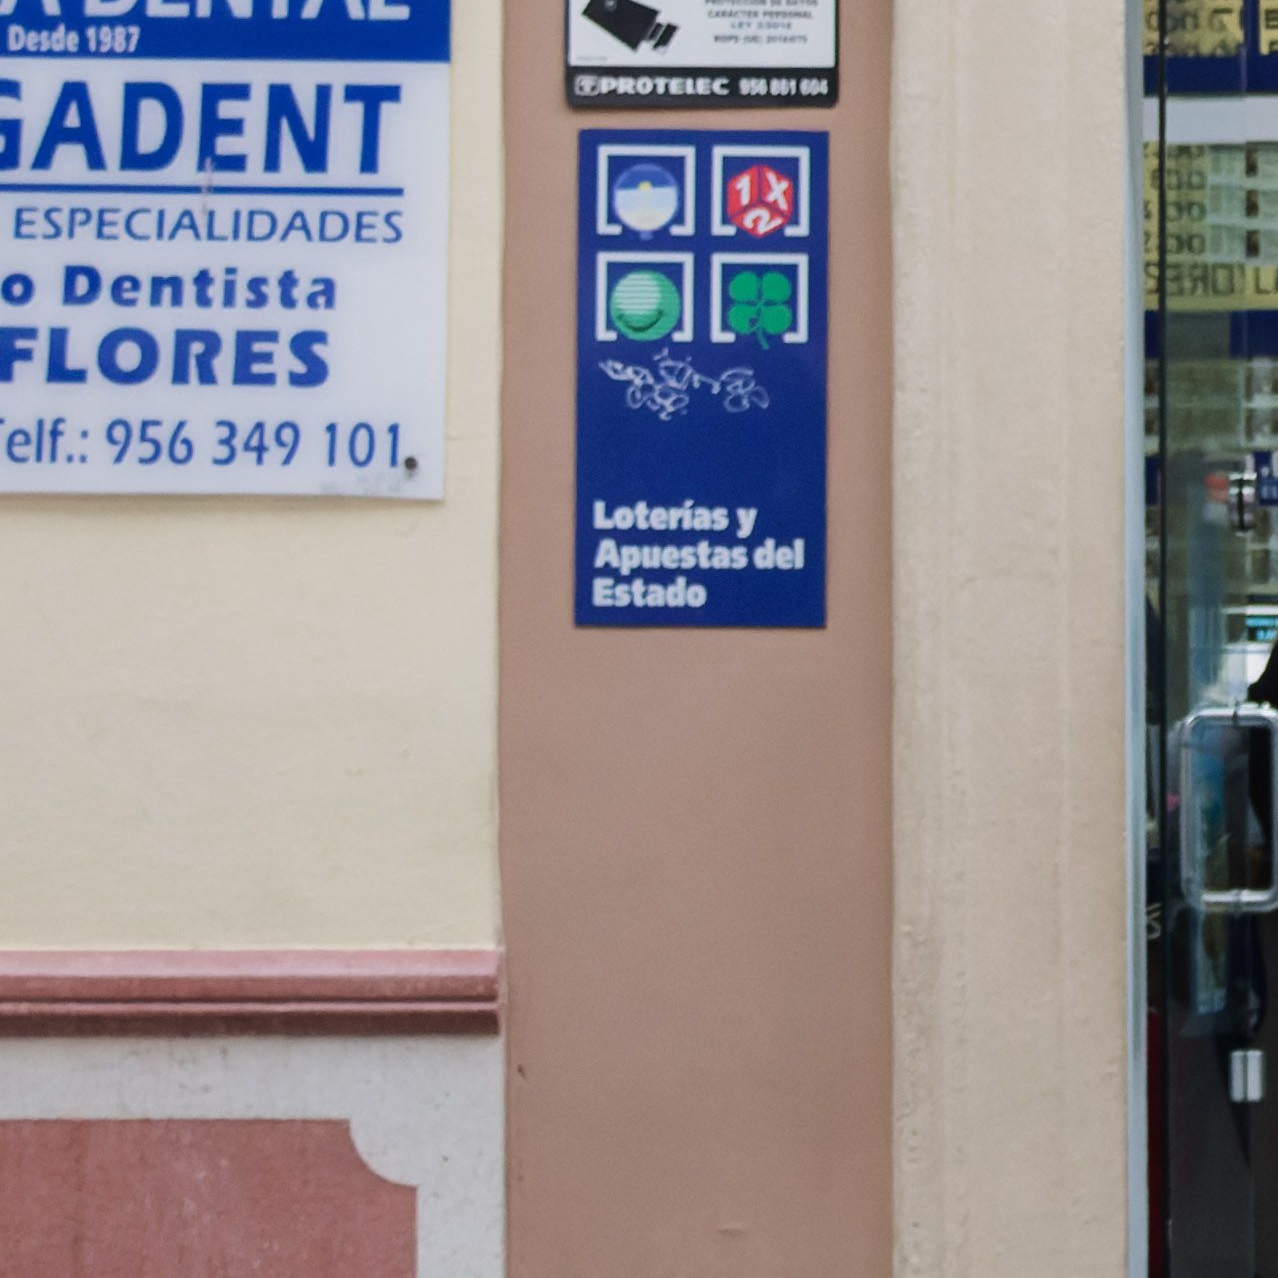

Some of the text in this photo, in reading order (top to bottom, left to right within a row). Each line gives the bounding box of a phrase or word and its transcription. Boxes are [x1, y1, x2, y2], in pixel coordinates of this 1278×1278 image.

[7, 23, 141, 54] Desde 1987
[602, 75, 730, 96] PROTELEC
[14, 207, 404, 244] ESPECIALIDADES
[0, 264, 336, 310] o Dentista
[0, 327, 330, 389] FLORES
[0, 417, 400, 468] elf.: 956 349 101
[593, 498, 758, 539] Loterías y
[594, 537, 805, 577] Apuestas del
[592, 576, 708, 608] Estado
